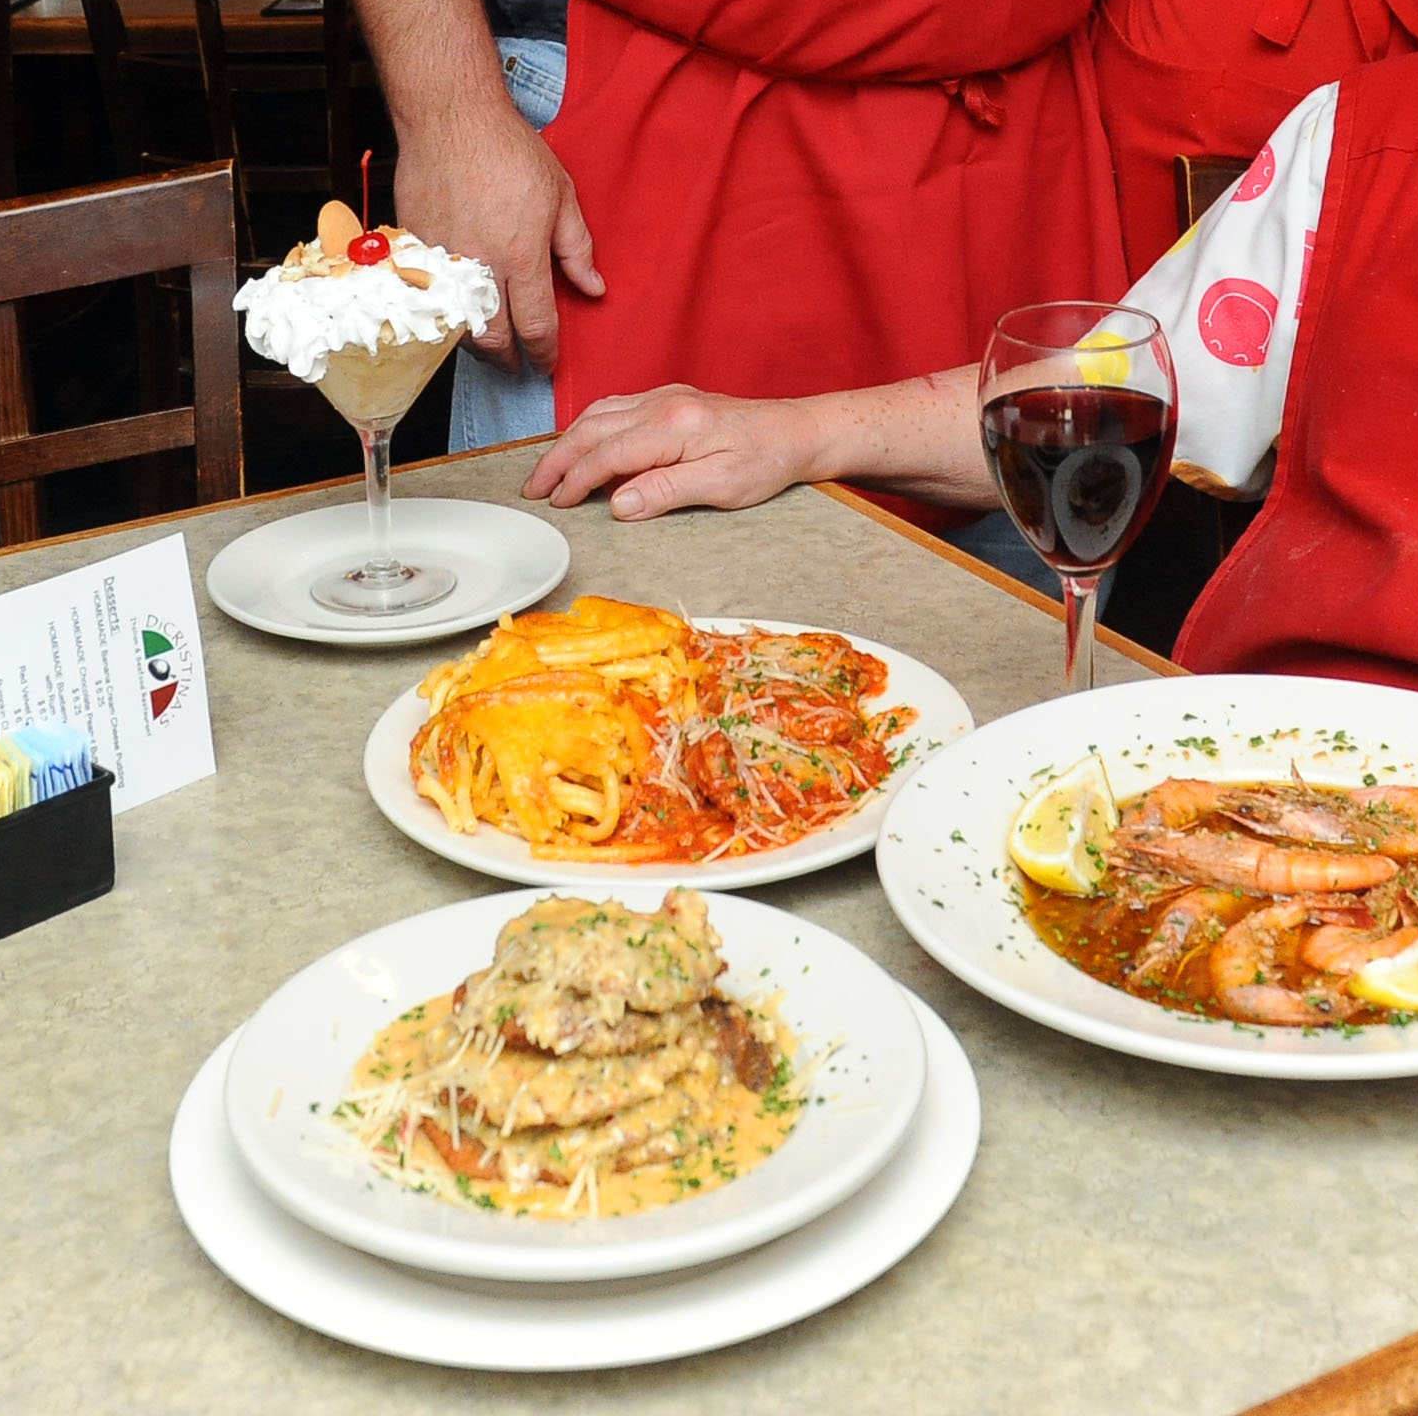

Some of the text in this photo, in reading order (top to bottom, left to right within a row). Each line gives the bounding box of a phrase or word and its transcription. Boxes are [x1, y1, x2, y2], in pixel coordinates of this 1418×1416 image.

[18, 664, 28, 685] Red
[47, 620, 63, 680] HOMEMADE
[70, 606, 85, 664] HOMEMADE
[78, 666, 91, 711] Chocolate
[21, 685, 32, 715] Velvet
[45, 674, 56, 716] with Rum
[92, 589, 125, 789] HOMEMADE Banana Cream Cheese Pudding
[135, 656, 146, 690] Seafood
[141, 691, 152, 737] Restaurant
